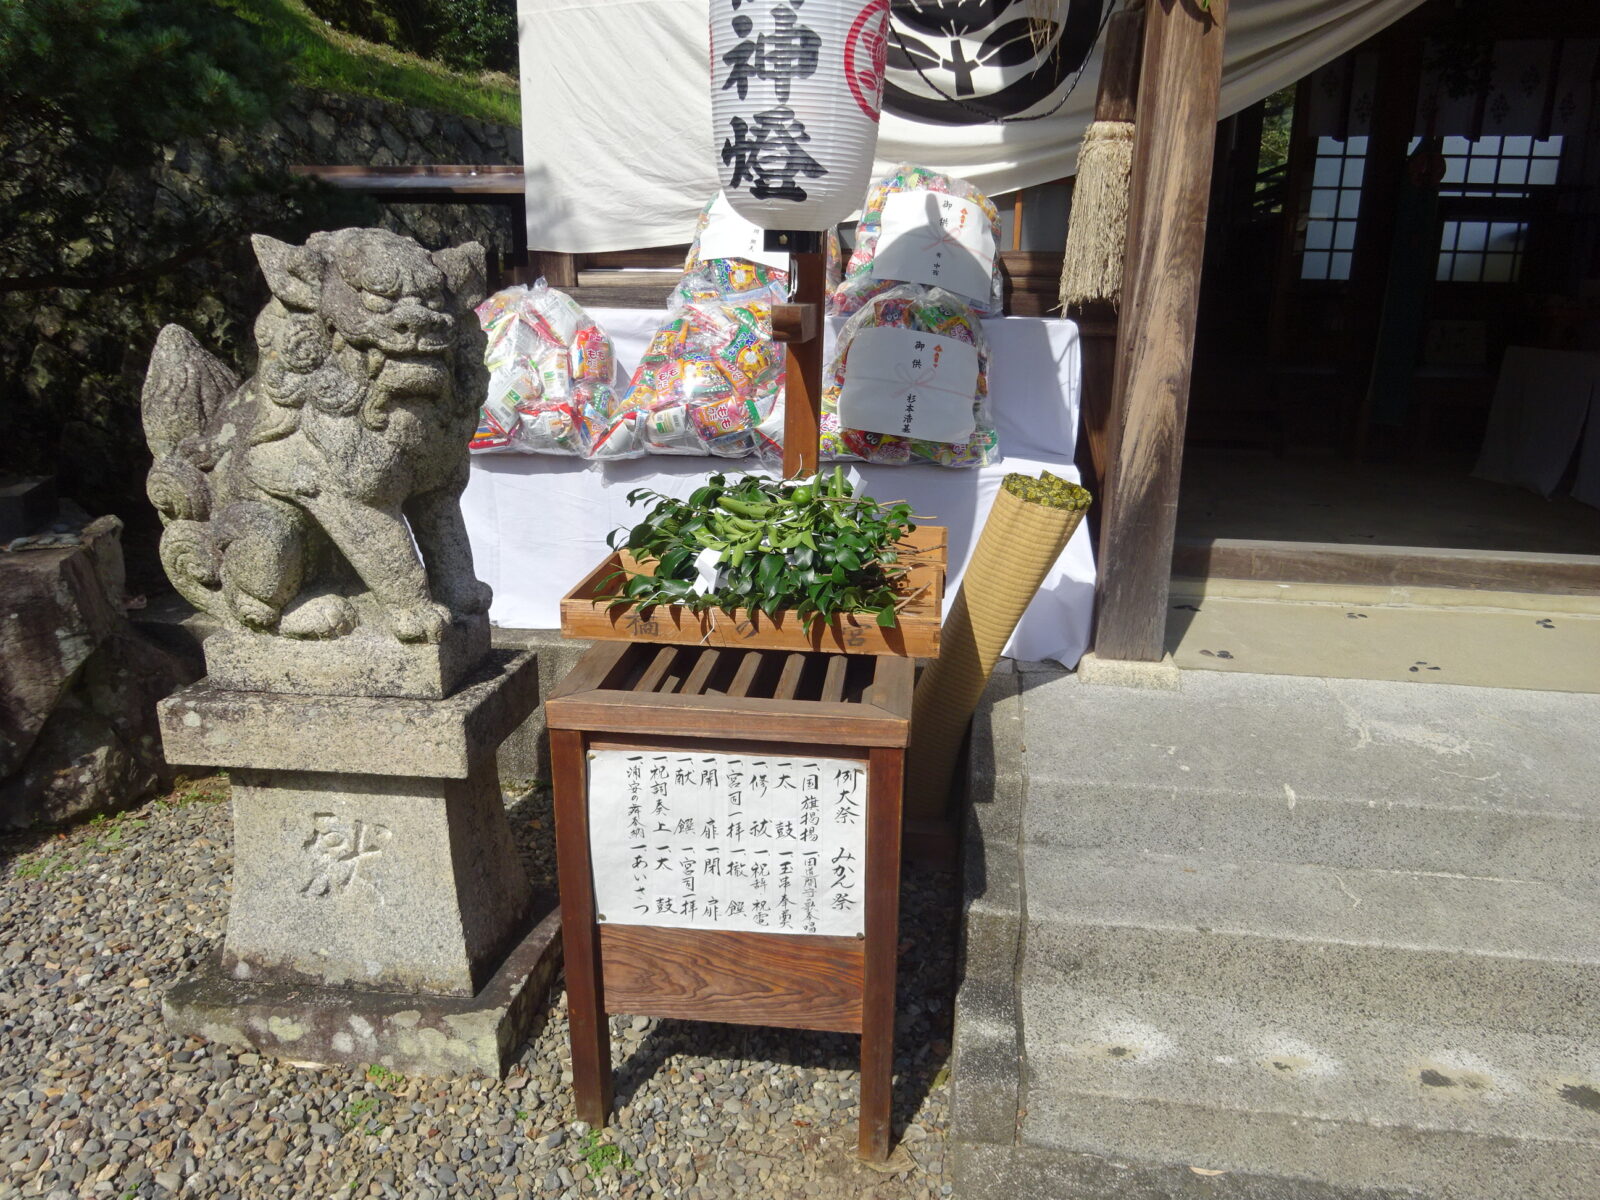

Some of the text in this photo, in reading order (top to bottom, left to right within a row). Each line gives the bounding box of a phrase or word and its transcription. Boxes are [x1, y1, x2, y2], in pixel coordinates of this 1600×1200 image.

[721, 0, 829, 203] 神燈
[834, 767, 861, 825] 例大祭
[830, 847, 857, 911] みかん祭
